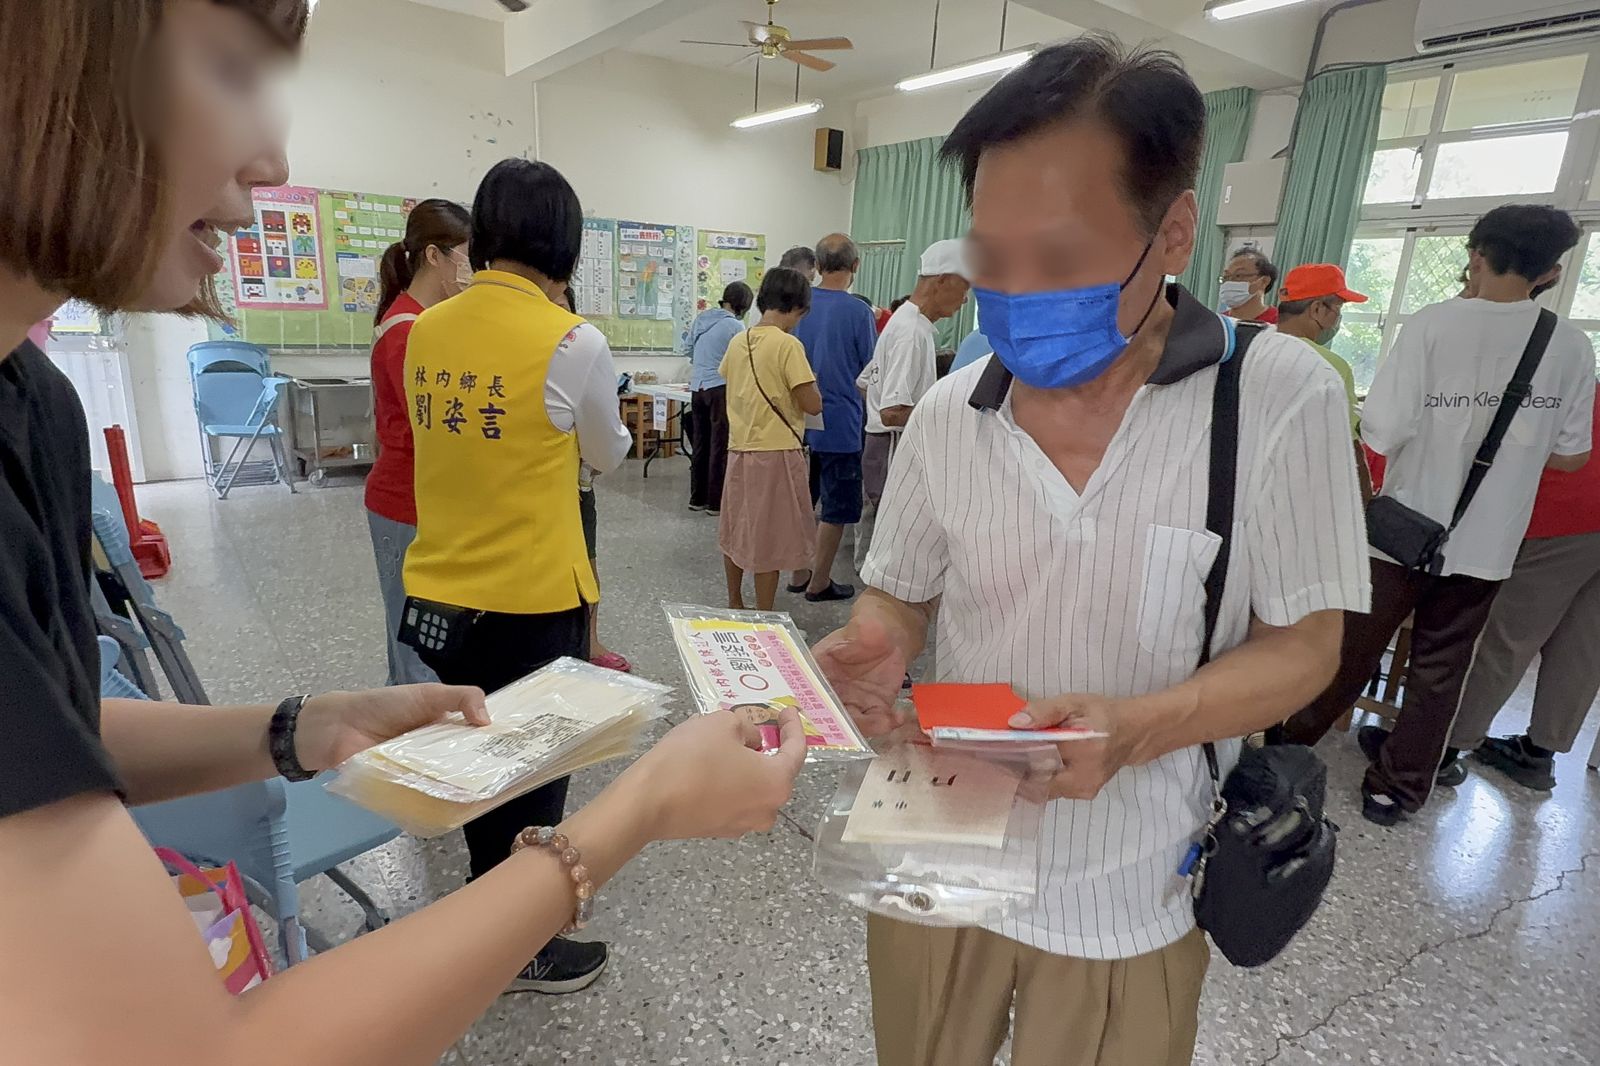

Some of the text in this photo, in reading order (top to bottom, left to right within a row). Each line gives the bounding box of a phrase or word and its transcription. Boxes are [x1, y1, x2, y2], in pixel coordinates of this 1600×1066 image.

[415, 366, 506, 399] 林內鄉長
[1474, 391, 1500, 407] Kle
[415, 392, 507, 440] 劉姿言
